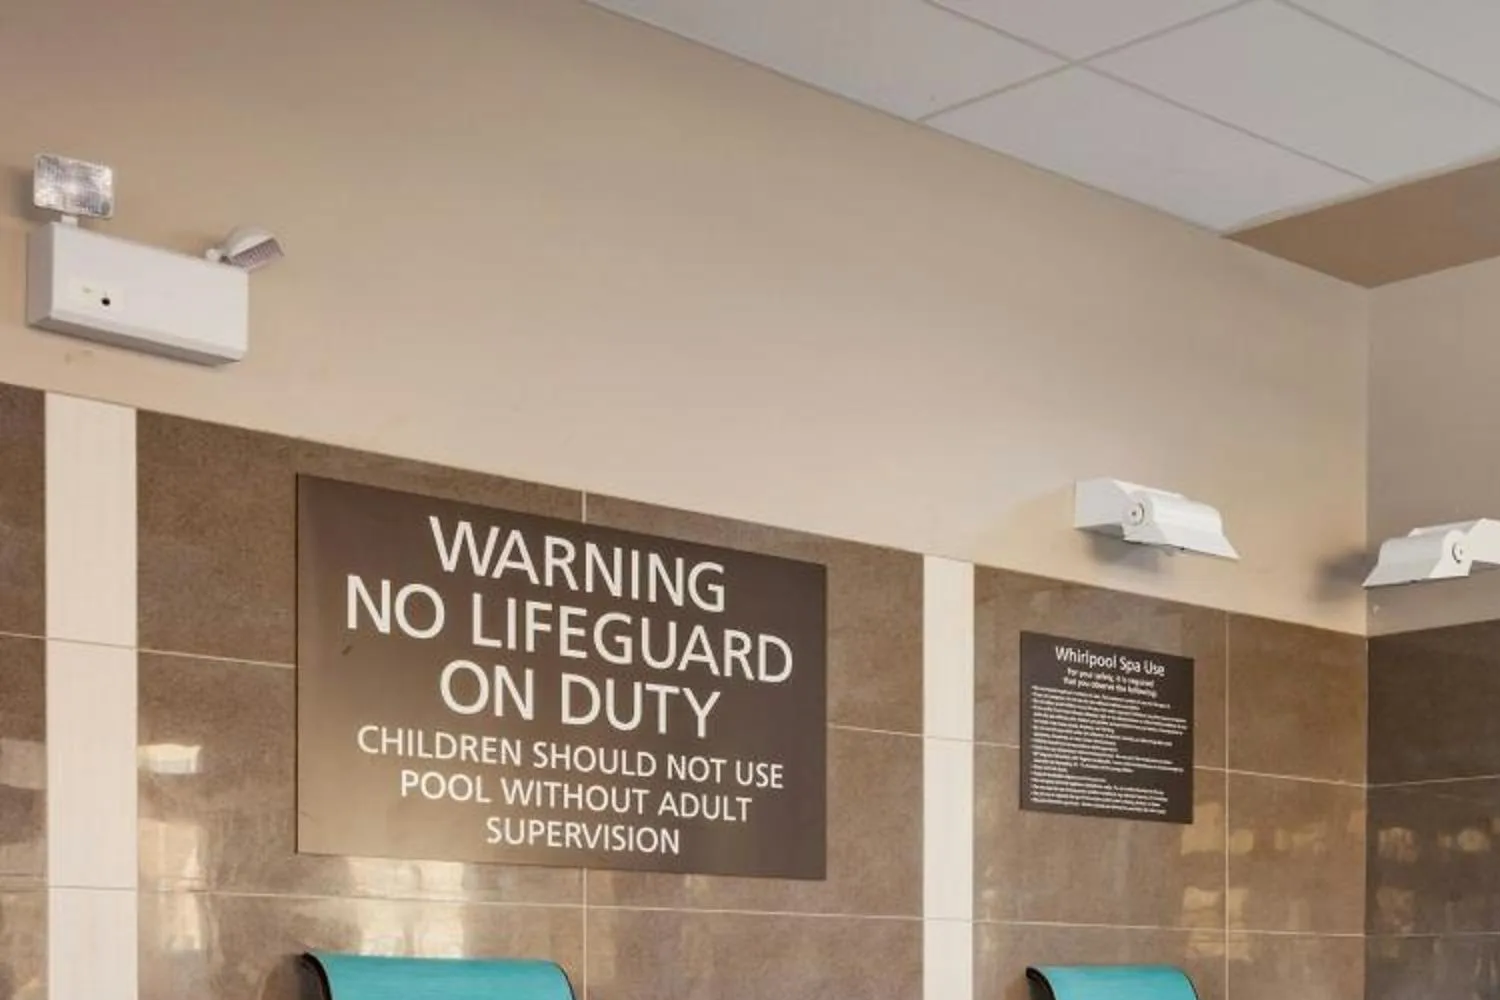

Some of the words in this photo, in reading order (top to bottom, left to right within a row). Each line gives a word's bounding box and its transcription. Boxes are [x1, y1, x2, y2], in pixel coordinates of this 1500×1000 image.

[428, 515, 725, 613] WARNING
[346, 573, 446, 640] NO
[472, 591, 793, 683] LIFEGUARD
[1055, 646, 1117, 668] Whirlpool
[1119, 656, 1141, 674] Spa
[1144, 660, 1165, 676] Use
[439, 659, 535, 721] ON
[560, 671, 721, 739] DUTY
[357, 724, 522, 767] CHILDREN
[532, 740, 657, 778] SHOULD
[666, 752, 728, 784] NOT
[735, 759, 784, 790] USE
[401, 769, 492, 804] POOL
[500, 777, 651, 815] WITHOUT
[657, 790, 753, 823] ADULT
[486, 816, 680, 855] SUPERVISION
